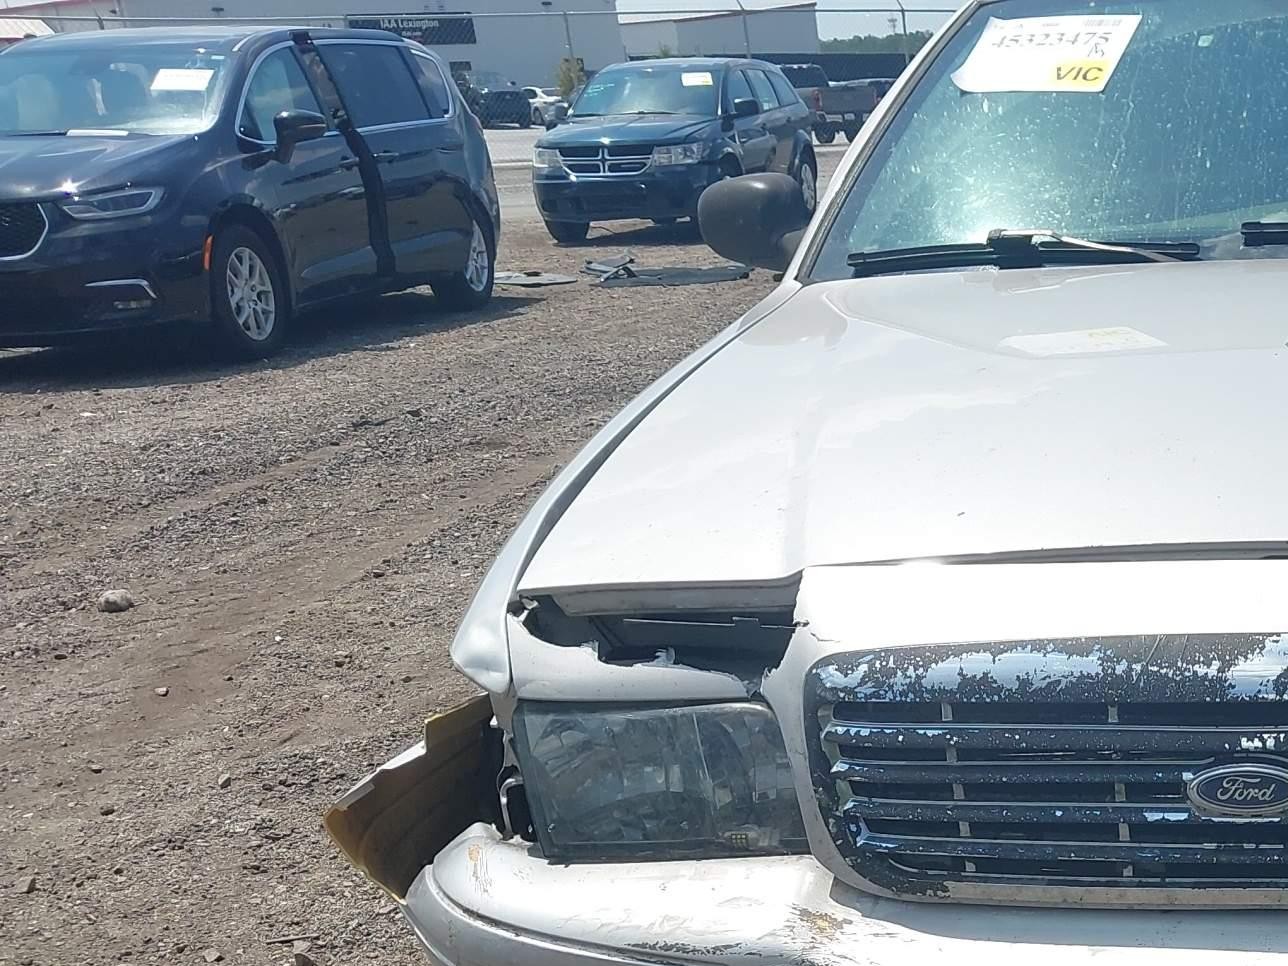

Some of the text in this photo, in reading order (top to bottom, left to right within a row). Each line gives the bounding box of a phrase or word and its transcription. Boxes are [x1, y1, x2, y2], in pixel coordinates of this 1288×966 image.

[380, 18, 439, 30] IAA Lexington
[991, 32, 1112, 48] 45323475
[1056, 66, 1104, 82] VIC
[1216, 776, 1276, 801] Ford
